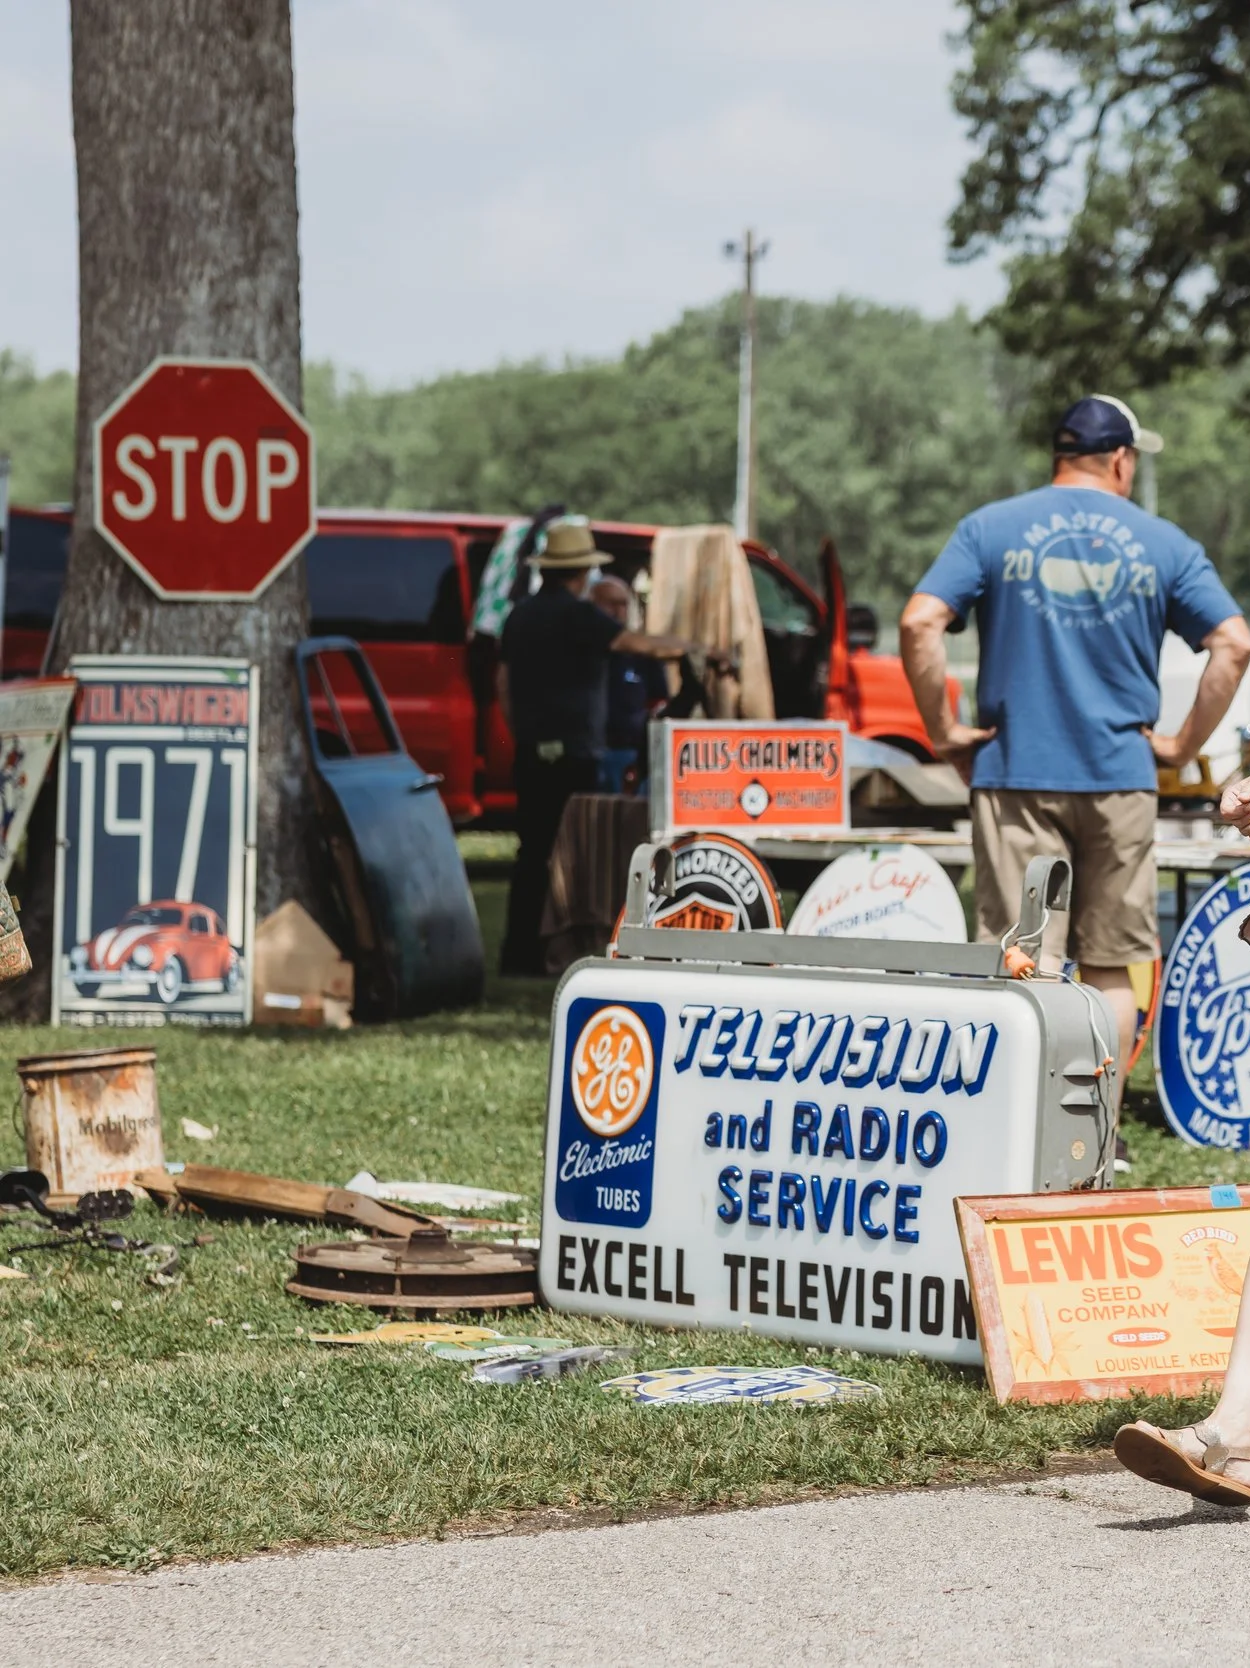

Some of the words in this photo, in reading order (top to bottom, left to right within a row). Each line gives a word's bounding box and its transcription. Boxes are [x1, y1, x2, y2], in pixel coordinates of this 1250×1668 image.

[112, 433, 300, 524] STOP
[1023, 511, 1146, 560] MASTERS
[1003, 547, 1035, 582] 20
[678, 739, 840, 778] ALLIS-CHALMERS
[69, 746, 248, 948] 1971
[1163, 926, 1205, 1008] BORN
[1205, 890, 1231, 925] IN
[673, 1003, 998, 1098] TELEVISION
[703, 1099, 773, 1152] and
[791, 1100, 948, 1168] RADIO
[1187, 1106, 1244, 1149] MADE
[559, 1134, 653, 1182] Electronic
[596, 1186, 641, 1213] TUBES
[716, 1165, 922, 1244] SERVICE
[992, 1222, 1164, 1285] LEWIS
[1181, 1228, 1206, 1247] RED
[1205, 1226, 1238, 1245] BIRD
[557, 1235, 695, 1306] EXCELL
[723, 1253, 977, 1341] TELEVISION
[1082, 1285, 1142, 1303] SEED
[1057, 1302, 1169, 1324] COMPANY
[1113, 1333, 1137, 1343] FIELD
[1138, 1331, 1166, 1342] SEEDS
[1190, 1352, 1229, 1367] KENT
